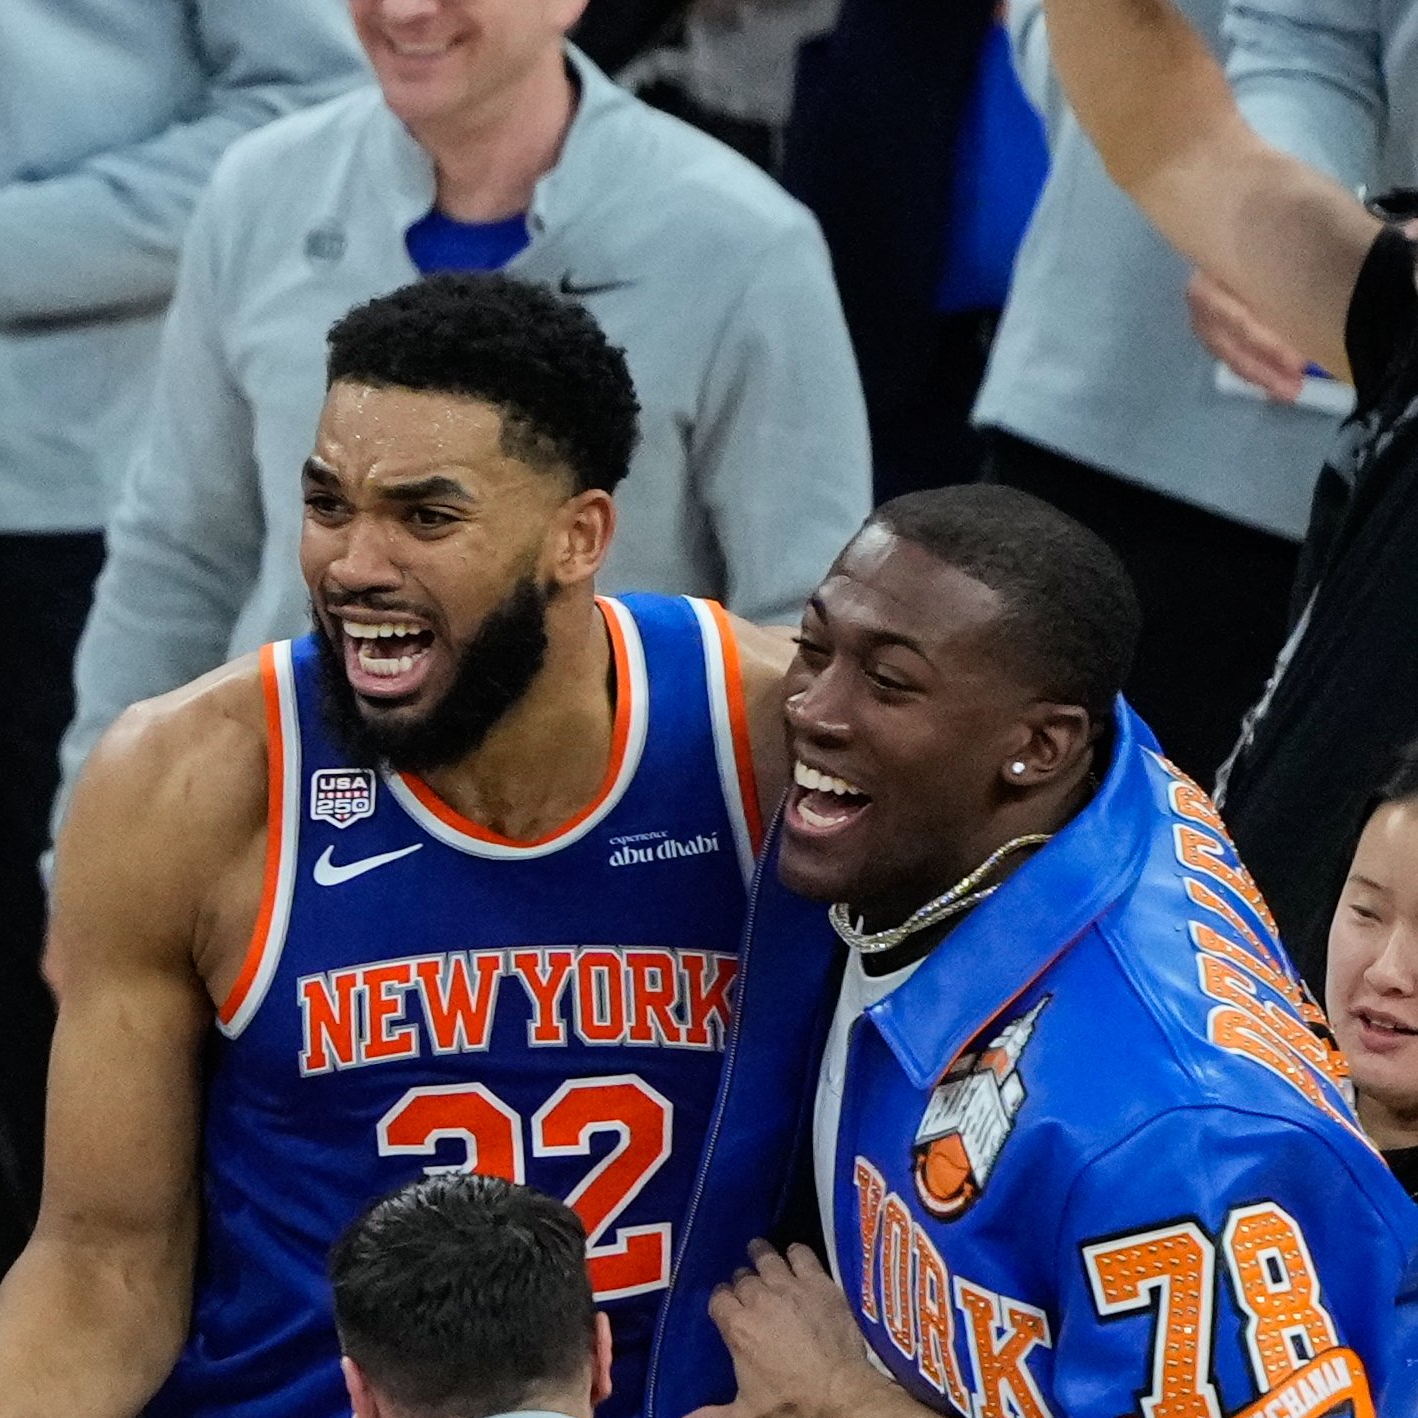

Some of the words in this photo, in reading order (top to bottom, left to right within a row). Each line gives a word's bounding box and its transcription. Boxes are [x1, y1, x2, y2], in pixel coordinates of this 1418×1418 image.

[320, 776, 368, 790] USA
[316, 798, 370, 814] 250
[609, 846, 654, 867] abu
[656, 832, 720, 860] dhabi
[298, 948, 501, 1078] NEW
[513, 945, 740, 1052] YORK
